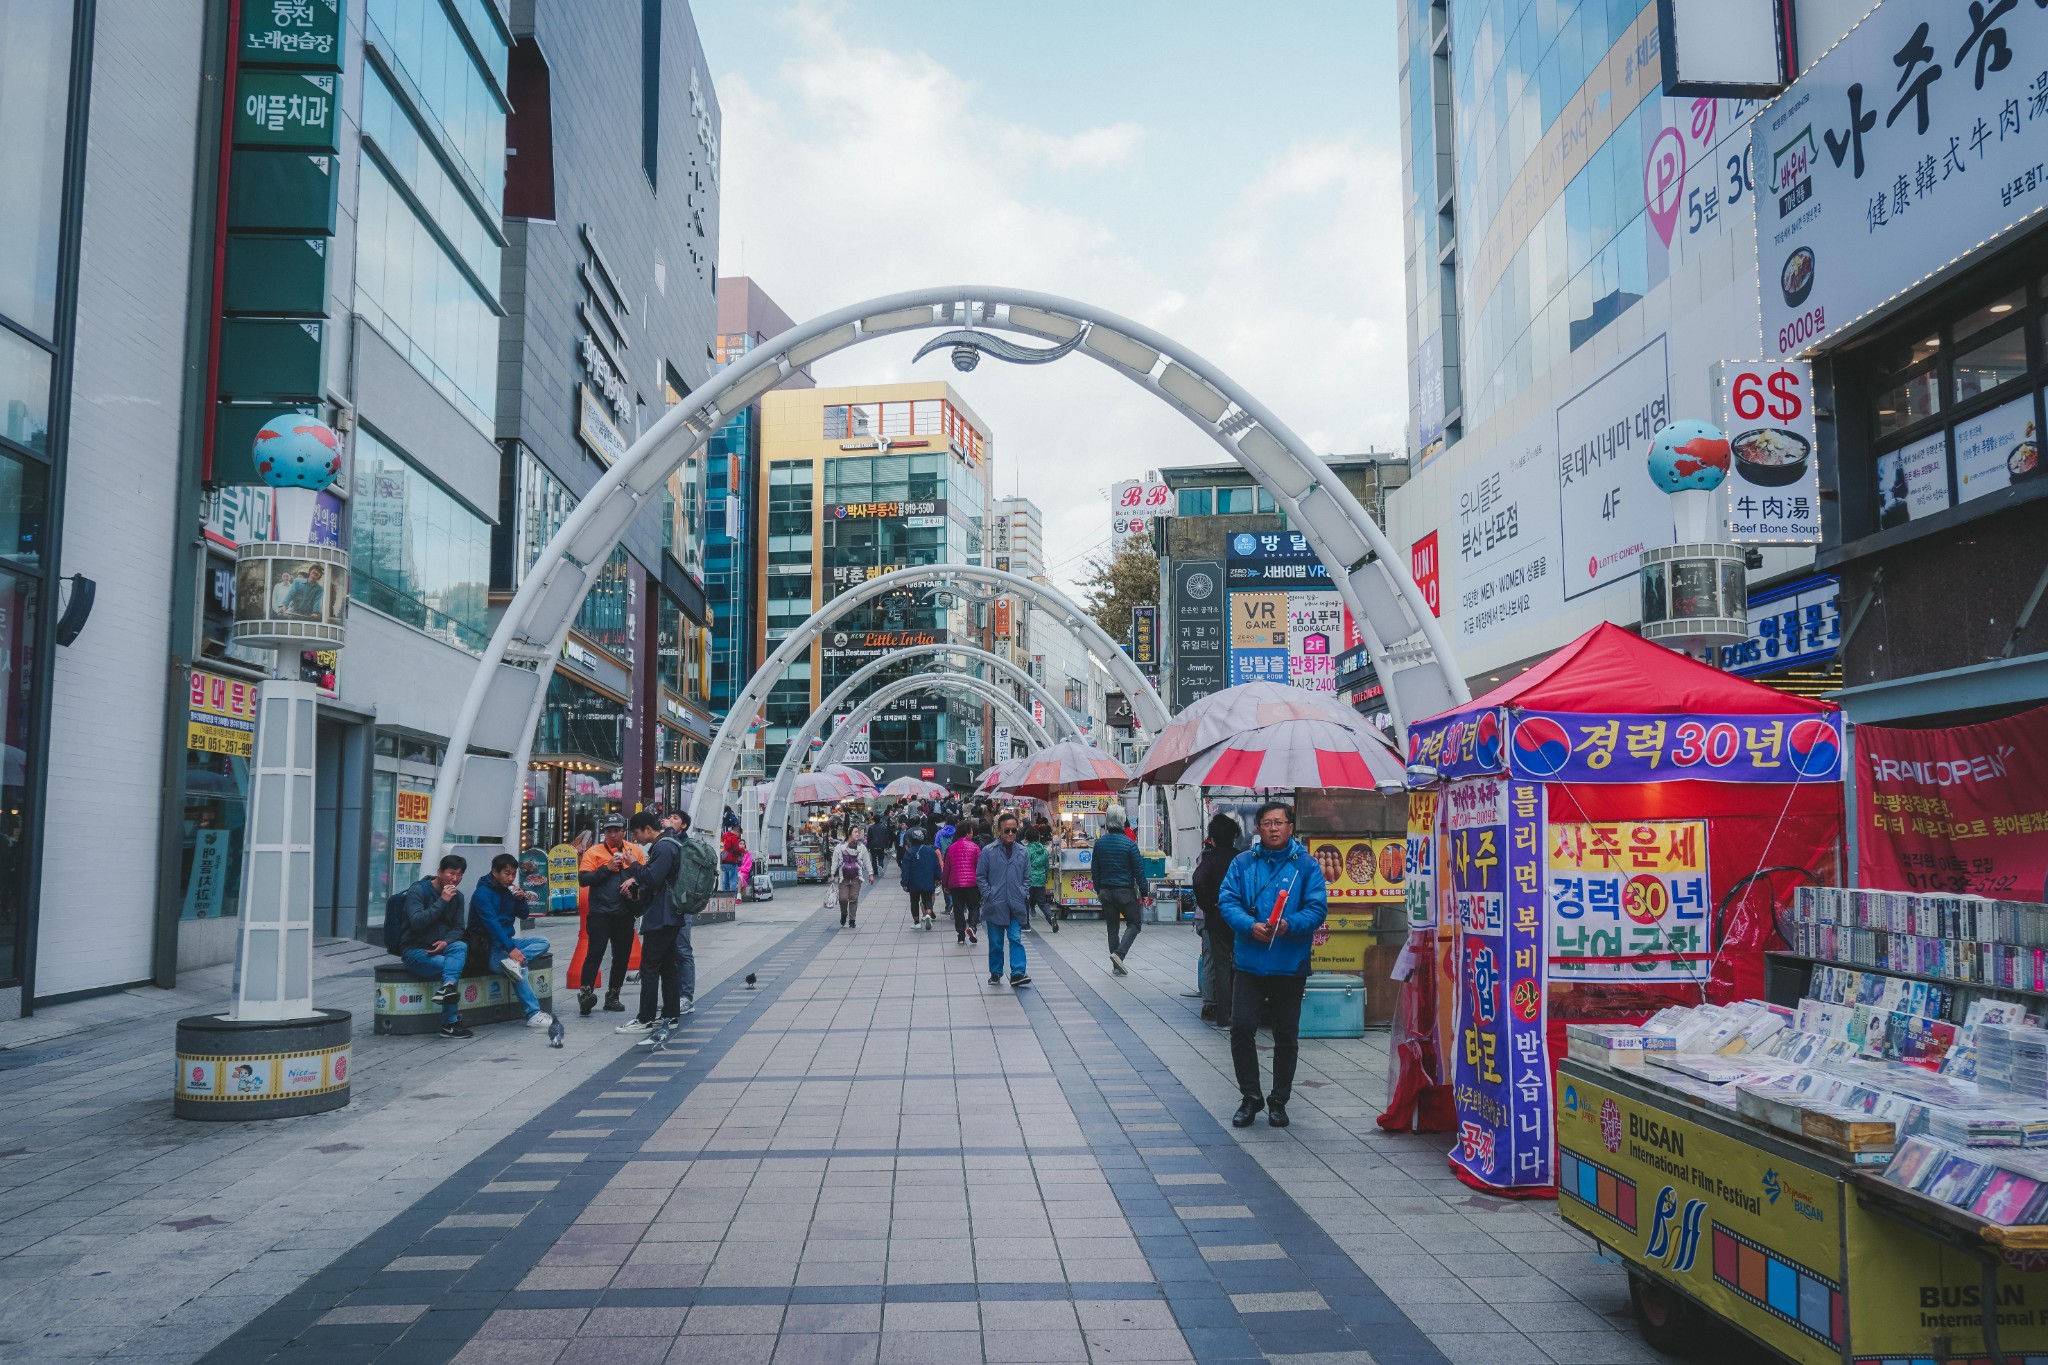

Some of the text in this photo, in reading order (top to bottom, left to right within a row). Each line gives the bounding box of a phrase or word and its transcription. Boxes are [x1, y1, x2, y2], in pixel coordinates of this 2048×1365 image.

[247, 31, 334, 53] 노래연습장
[318, 77, 332, 87] 5F
[246, 94, 329, 131] 애플치과
[314, 157, 326, 167] 4F
[1688, 186, 1720, 235] 5분
[312, 240, 323, 251] 3F
[307, 324, 319, 336] 2F
[1778, 305, 1826, 354] 6000원
[1731, 366, 1803, 426] 6$
[1561, 417, 1630, 489] 롯데시네마
[1635, 393, 1668, 440] 대영
[1460, 471, 1503, 526] 유니클로
[1602, 488, 1621, 522] 4F
[1737, 496, 1811, 520] 牛肉湯
[847, 502, 899, 518] 박사부동산
[905, 502, 935, 515] 919-5500
[1461, 501, 1519, 563] 부산 남포점
[1731, 523, 1820, 536] Beef Bone Soup
[1414, 544, 1434, 580] UNI
[1598, 542, 1645, 569] LOTTE CINEMA
[1262, 564, 1306, 578] 서바이벌
[1481, 579, 1495, 602] MEN
[1499, 566, 1525, 594] WOMEN
[1244, 602, 1276, 619] VR
[1245, 620, 1277, 629] GAME
[1292, 624, 1341, 632] BOOK&CAFE
[863, 632, 899, 647] Little
[899, 631, 936, 646] India
[1181, 640, 1220, 650] 쥬얼리샵
[1273, 634, 1285, 643] 3F
[1305, 640, 1325, 650] 2F
[823, 649, 845, 657] Indian
[845, 648, 881, 657] Restaurant
[1187, 663, 1214, 672] Jewelry
[1239, 656, 1284, 673] 방탈출
[1181, 677, 1220, 686] ジュエリー
[191, 734, 206, 749] 문의
[398, 793, 429, 820] 임대문의
[1066, 800, 1098, 809] 납작만두
[1553, 825, 1698, 869] 사주운세
[1455, 829, 1498, 891] 사주
[1464, 1022, 1503, 1085] 타로
[1629, 1112, 1685, 1158] BUSAN
[1629, 1139, 1762, 1217] International Film Festival
[1793, 1200, 1825, 1223] BUSAN
[1919, 1284, 2025, 1308] BUSN
